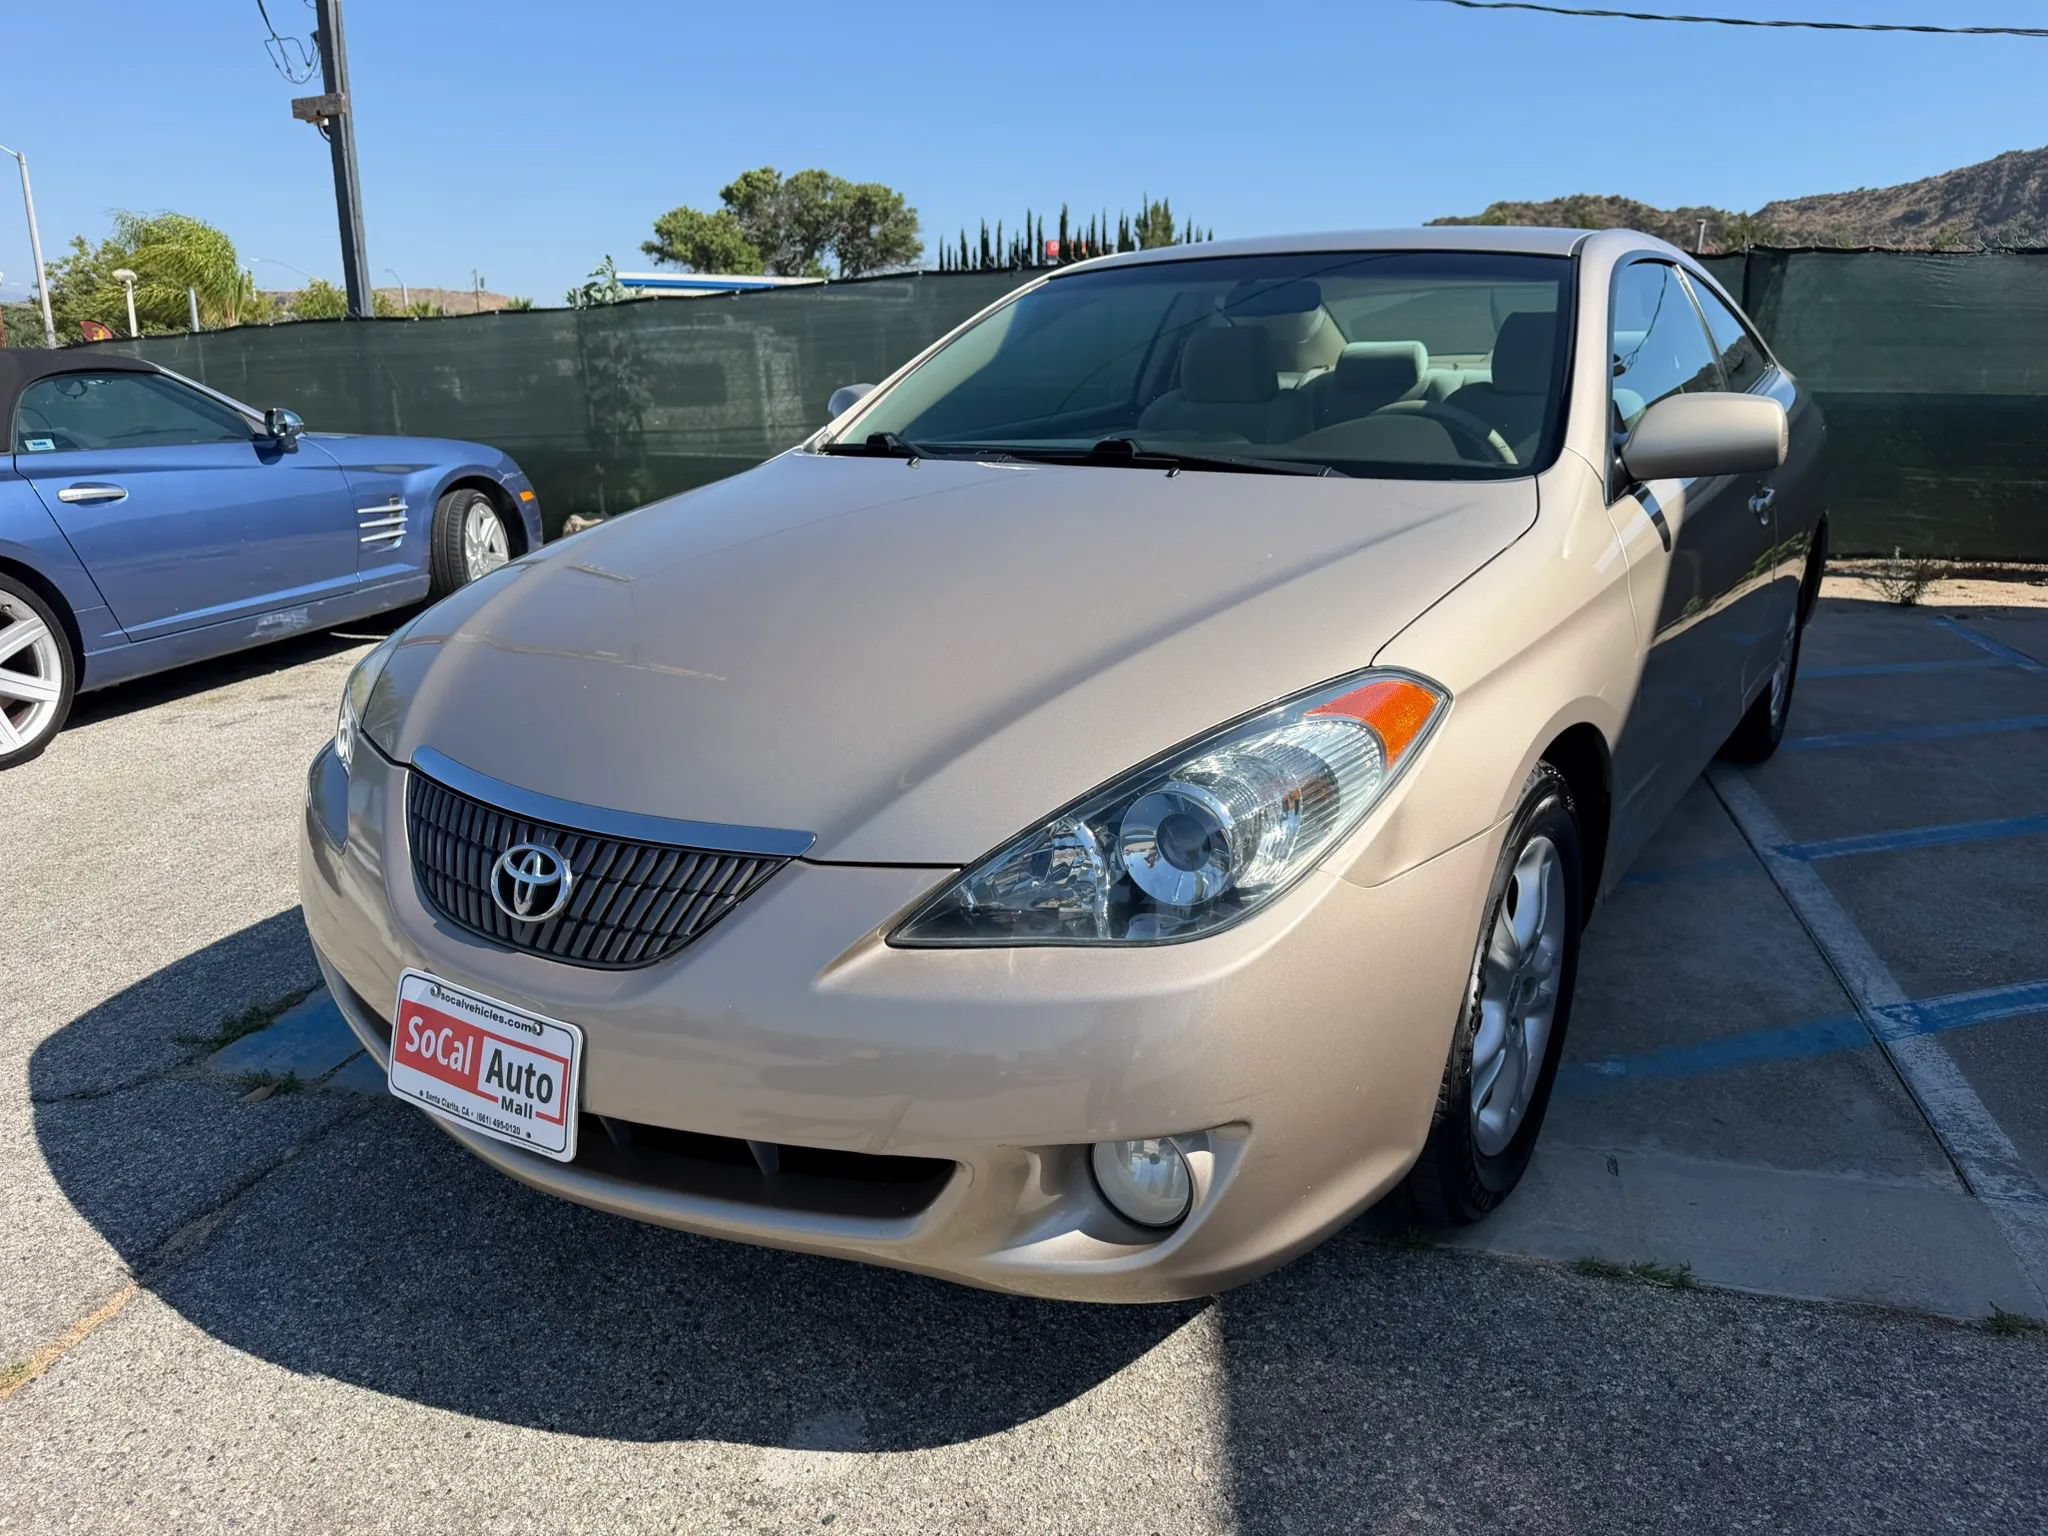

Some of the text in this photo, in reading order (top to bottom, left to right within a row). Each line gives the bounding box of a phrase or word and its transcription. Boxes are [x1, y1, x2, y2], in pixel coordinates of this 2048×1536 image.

[440, 991, 532, 1033] socalvehicles.com
[405, 1015, 474, 1075] SoCal
[485, 1048, 554, 1104] Auto
[425, 1090, 440, 1104] Santa
[461, 1106, 470, 1117] CA
[501, 1095, 533, 1120] Mall
